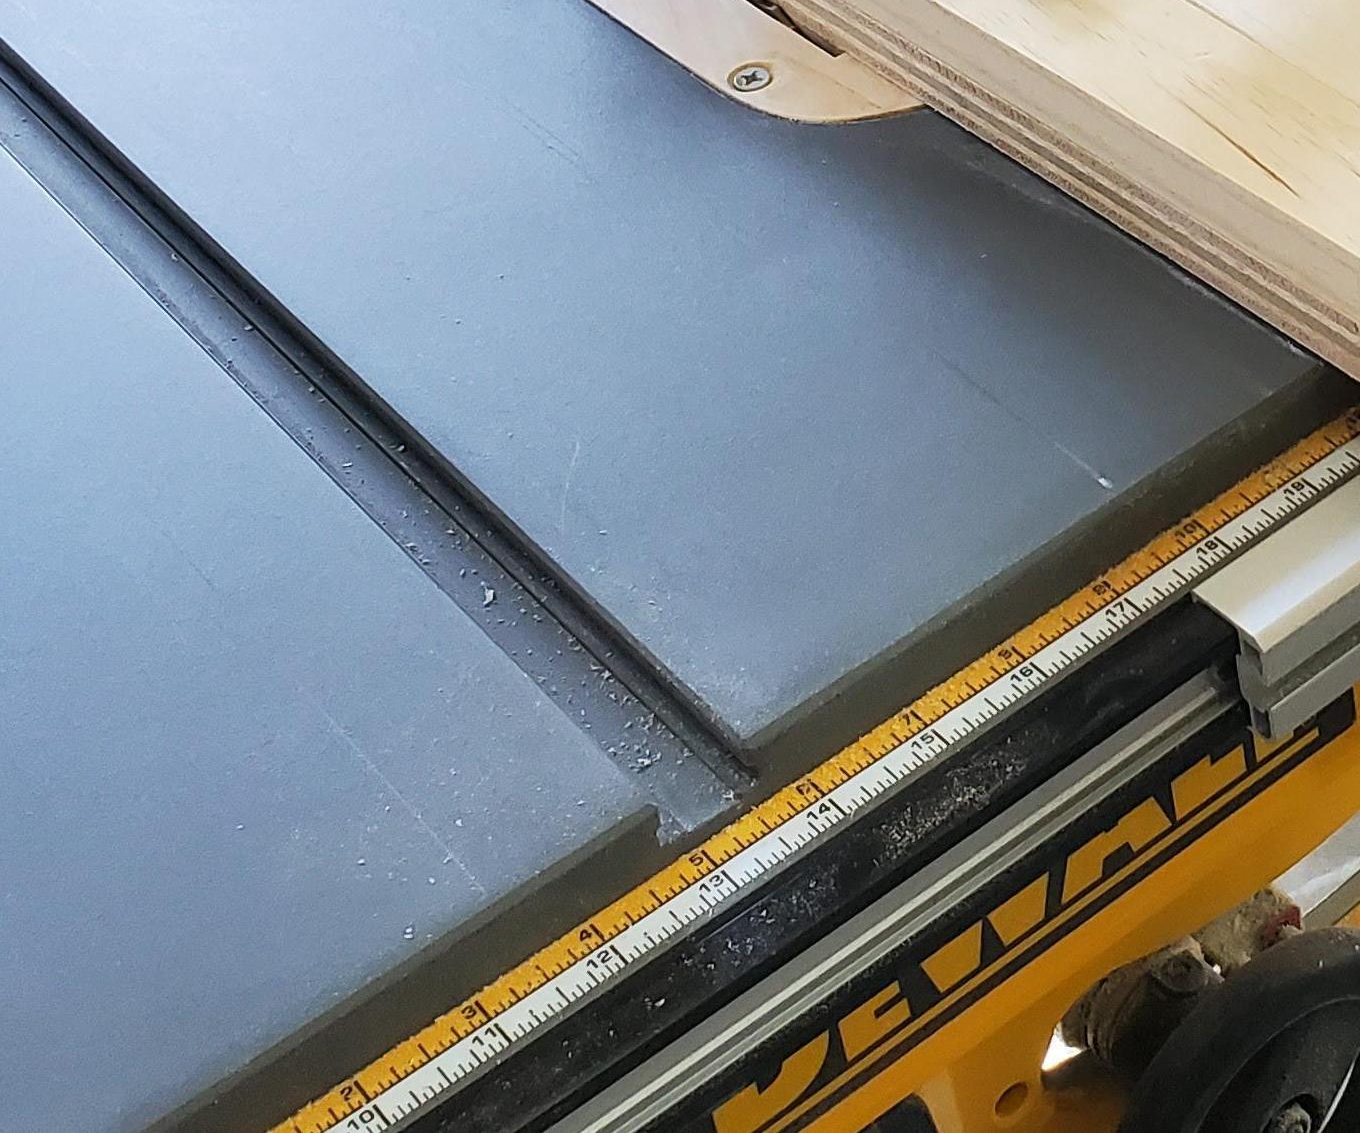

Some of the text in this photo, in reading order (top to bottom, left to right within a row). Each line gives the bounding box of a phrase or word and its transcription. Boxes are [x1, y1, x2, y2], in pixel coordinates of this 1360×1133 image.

[1283, 482, 1305, 496] 19
[1175, 522, 1196, 539] 10
[1196, 539, 1219, 557] 18
[1105, 601, 1127, 618] 17
[1010, 666, 1034, 683] 16
[911, 733, 936, 751] 15
[806, 802, 832, 821] 14
[688, 853, 704, 866] 5
[699, 874, 725, 893] 13
[579, 928, 593, 943] 4
[587, 949, 613, 970] 12
[461, 1005, 477, 1020] 3
[471, 1025, 499, 1047] 11
[339, 1085, 354, 1102] 2
[346, 1109, 376, 1131] 10
